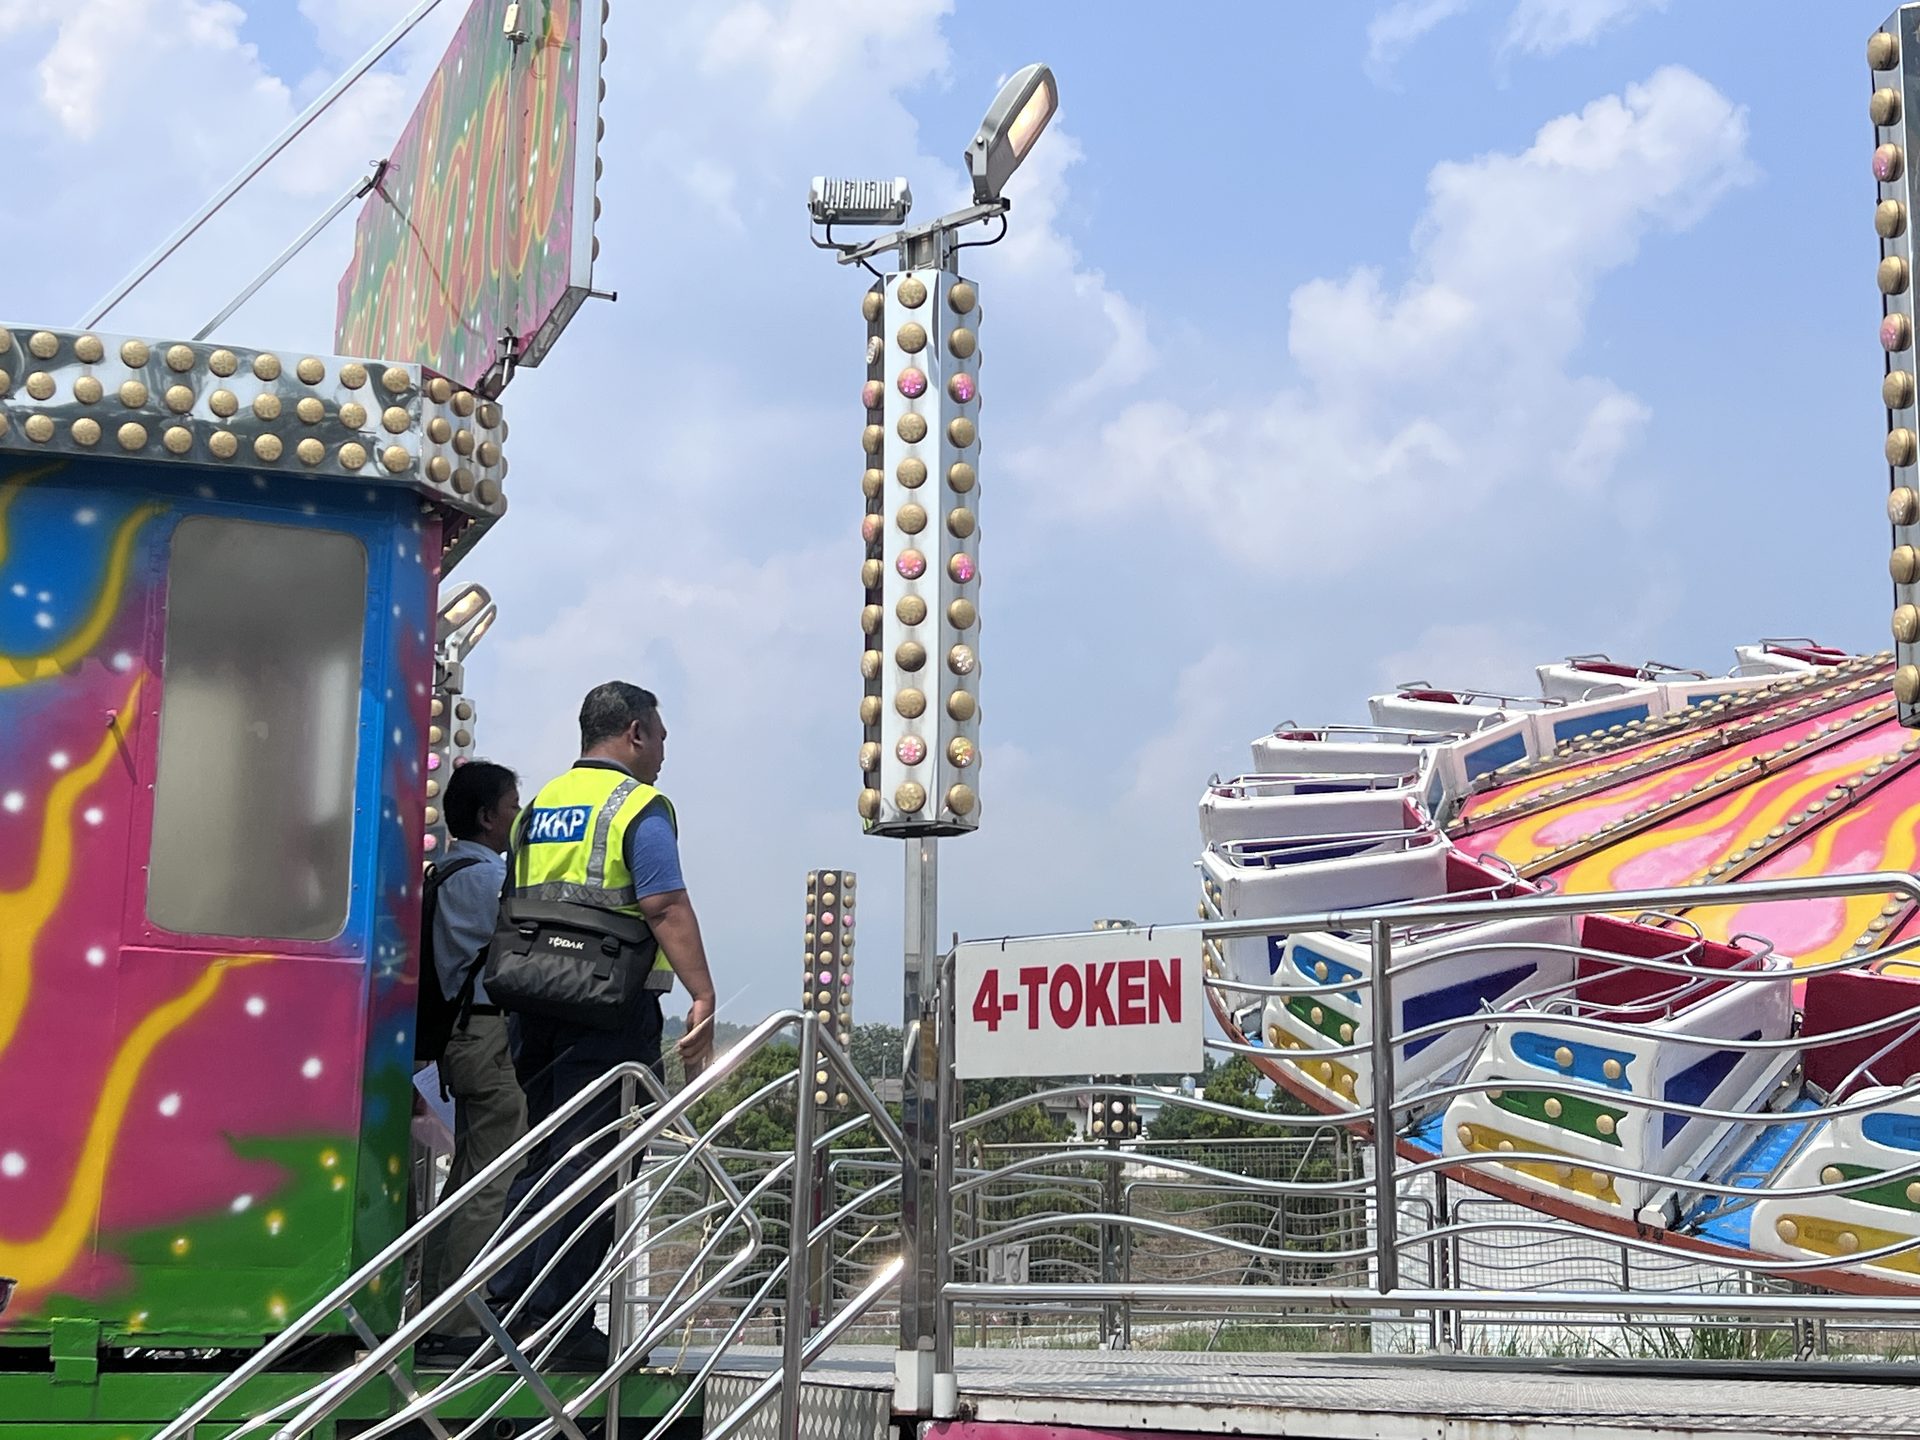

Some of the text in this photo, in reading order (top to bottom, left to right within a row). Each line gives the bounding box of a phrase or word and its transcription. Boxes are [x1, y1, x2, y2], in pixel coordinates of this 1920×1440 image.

[527, 809, 586, 840] JKKP
[548, 936, 585, 950] TODAK
[972, 958, 1182, 1032] 4-TOKEN
